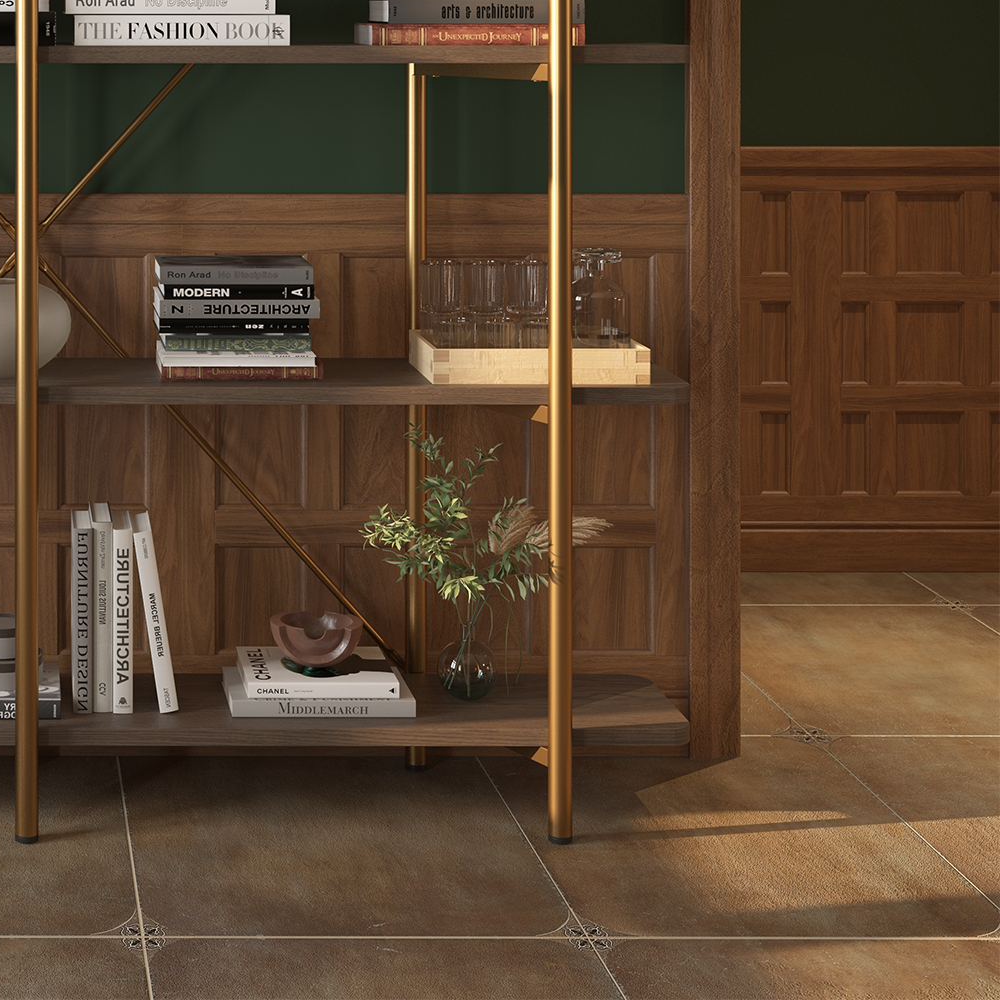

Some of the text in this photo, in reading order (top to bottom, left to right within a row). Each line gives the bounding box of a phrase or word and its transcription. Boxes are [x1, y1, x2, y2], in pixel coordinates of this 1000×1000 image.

[441, 3, 460, 18] arts
[476, 2, 534, 18] architecture
[76, 22, 122, 39] THE
[128, 22, 218, 39] FASHION
[166, 270, 186, 278] Ron
[172, 287, 229, 297] MODERN
[290, 287, 303, 296] A
[203, 304, 310, 314] ARCHITECTURE
[247, 649, 272, 681] CHANEL
[278, 701, 368, 714] MIDDLEMARCH
